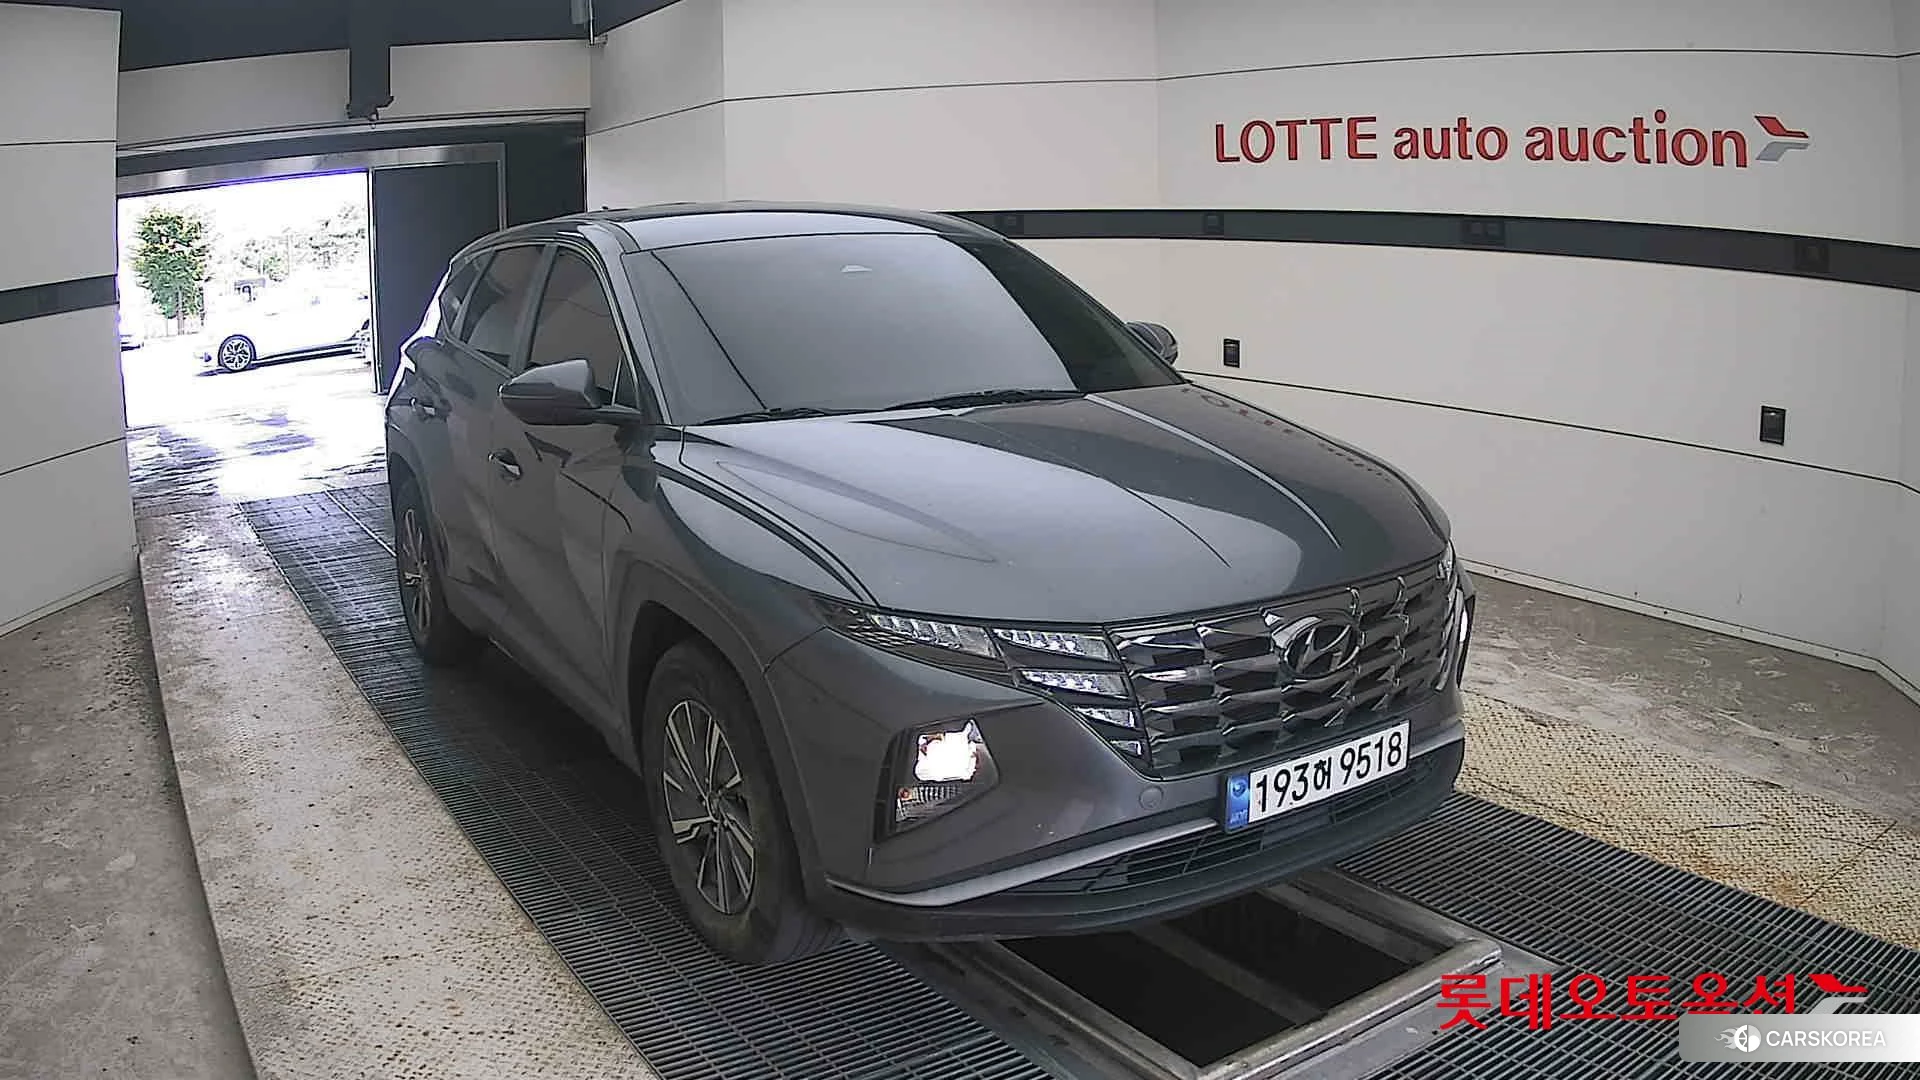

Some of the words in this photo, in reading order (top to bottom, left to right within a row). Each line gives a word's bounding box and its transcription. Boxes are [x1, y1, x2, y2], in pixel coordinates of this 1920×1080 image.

[1215, 116, 1377, 163] LOTTE
[1393, 117, 1509, 161] auto
[1524, 109, 1749, 168] auction
[1255, 755, 1332, 812] 193허
[1340, 731, 1402, 784] 9518
